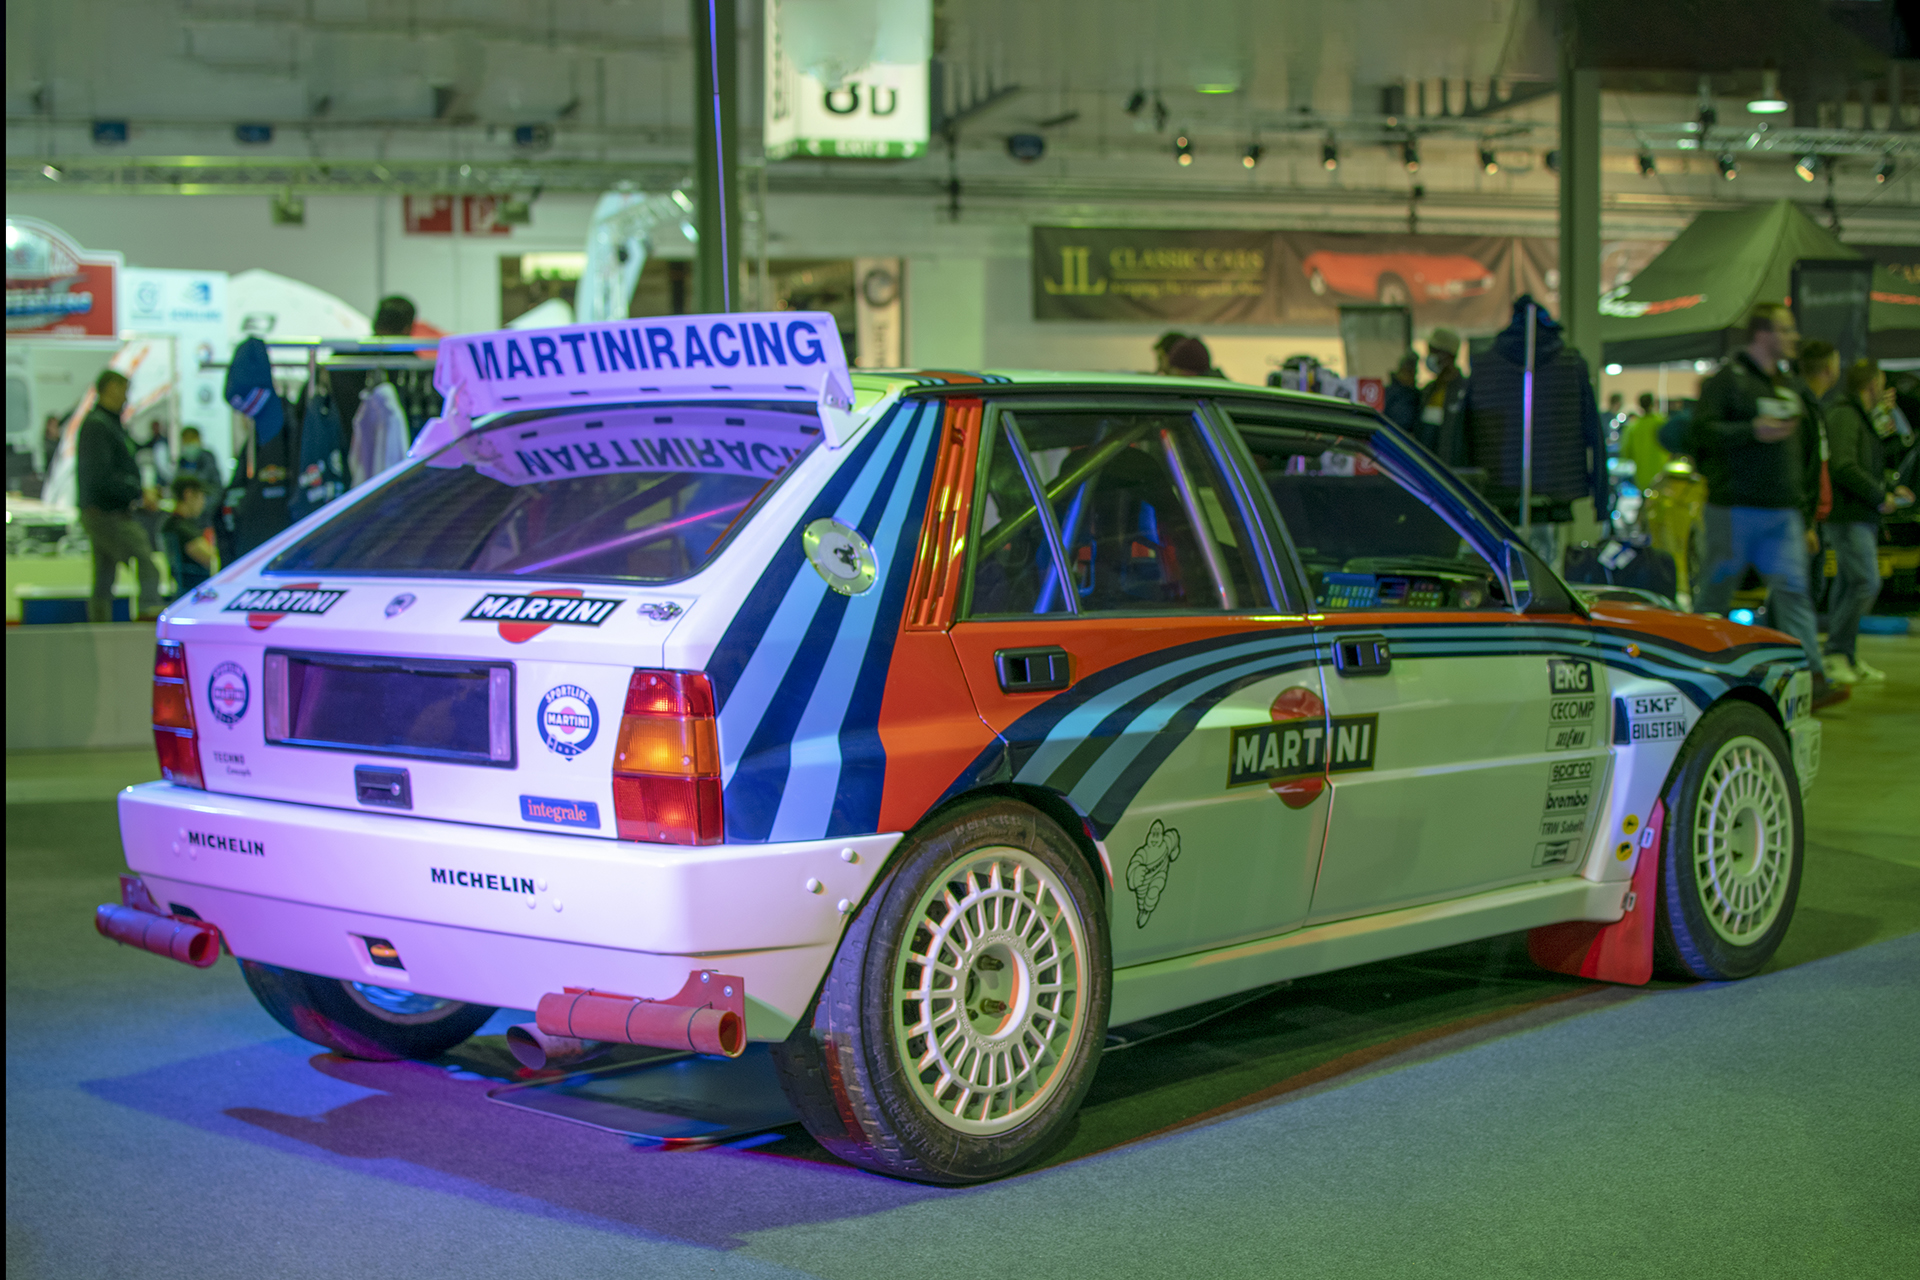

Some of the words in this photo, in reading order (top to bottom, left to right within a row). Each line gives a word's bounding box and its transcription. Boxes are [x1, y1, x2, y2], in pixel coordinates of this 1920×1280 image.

[467, 320, 826, 381] MARTINIRACING
[230, 590, 339, 612] MARTINI
[472, 595, 615, 624] MARTINI
[1555, 662, 1588, 690] ERG
[544, 685, 591, 704] SPORTLINE
[1635, 697, 1677, 713] SKF
[548, 712, 588, 728] MARTINI
[1551, 701, 1594, 720] CECOMP
[1632, 721, 1686, 739] BILSTEIN
[1235, 723, 1372, 776] MARTINI
[1552, 762, 1592, 782] sparco
[1546, 789, 1588, 810] brembo
[528, 799, 587, 823] integrale
[188, 831, 265, 857] MICHELIN
[430, 866, 536, 896] MICHELIN
